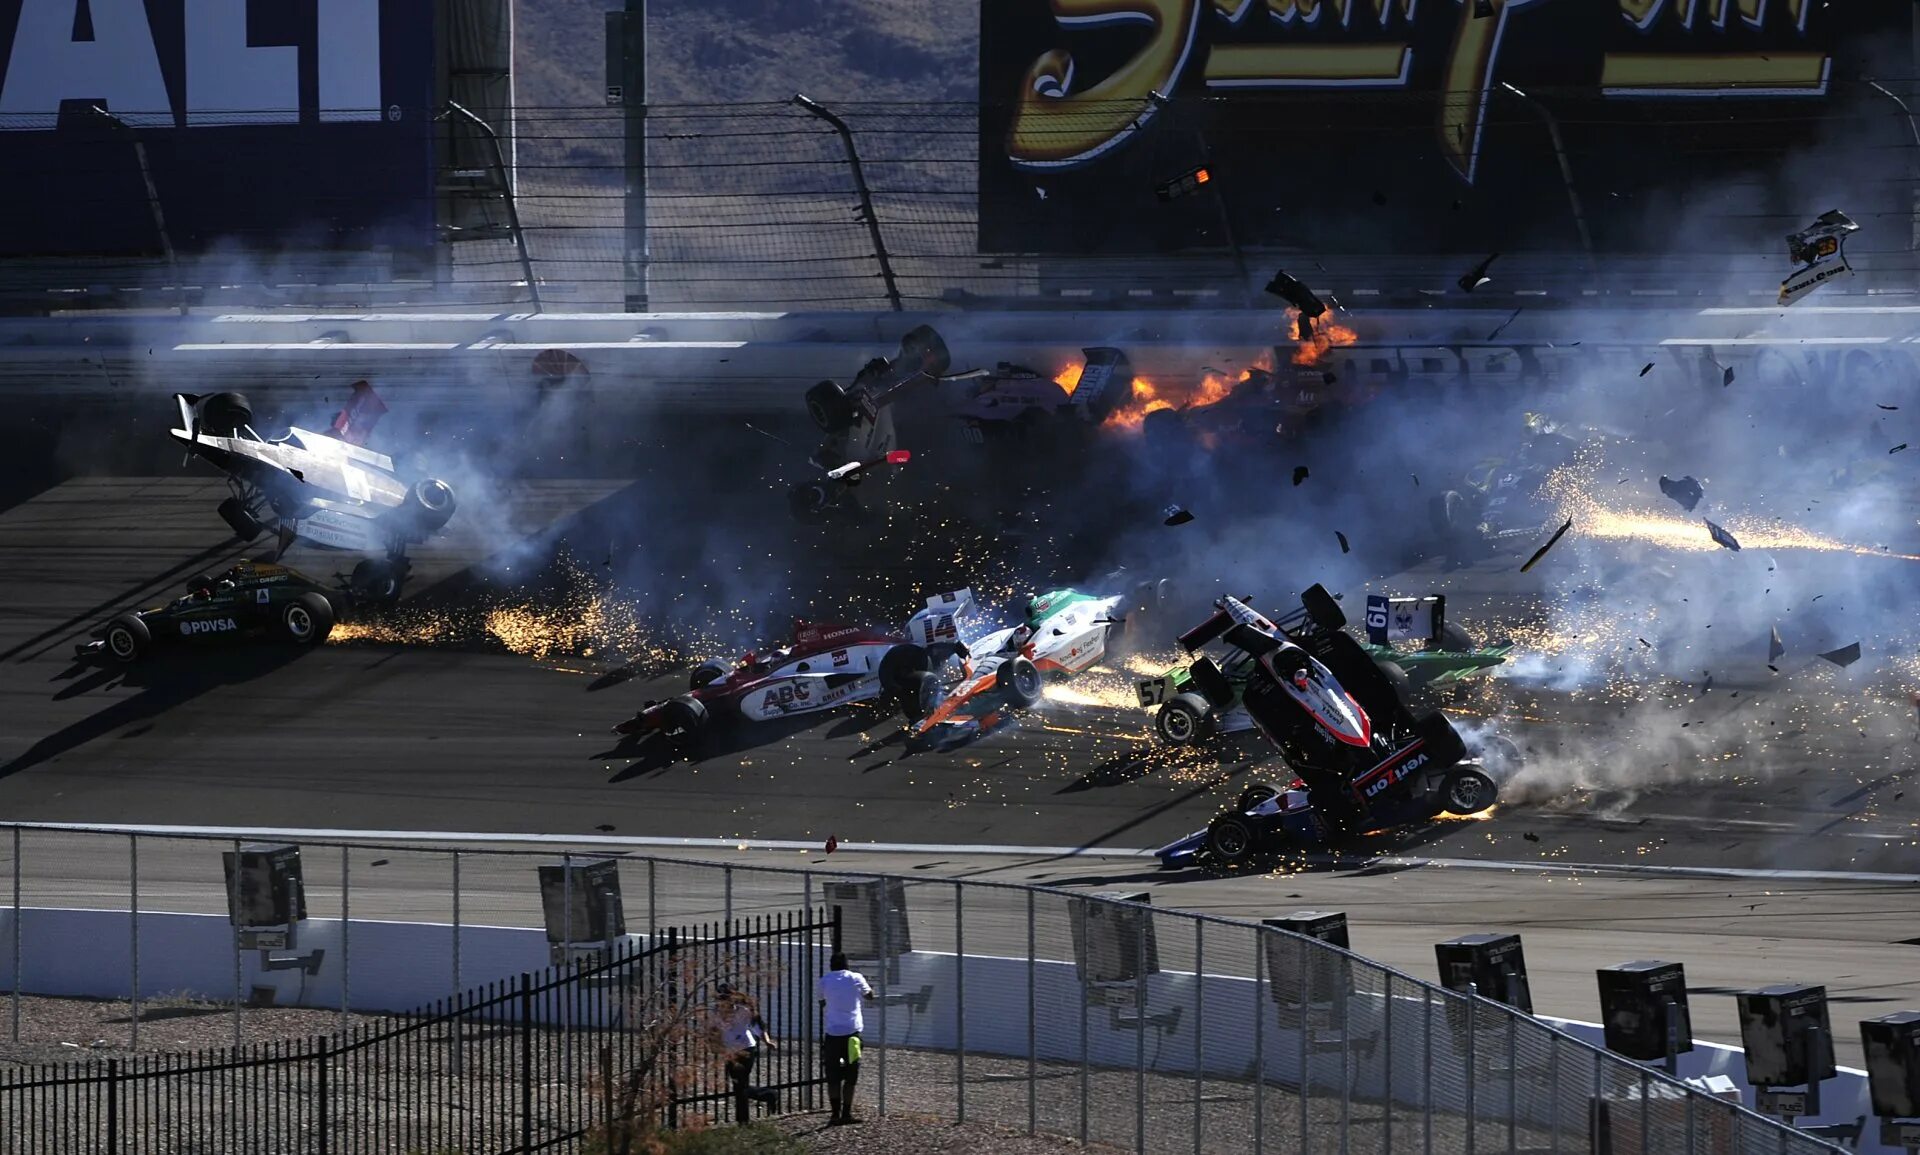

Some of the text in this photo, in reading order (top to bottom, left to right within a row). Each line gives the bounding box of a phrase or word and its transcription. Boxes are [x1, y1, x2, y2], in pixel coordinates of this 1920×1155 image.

[191, 618, 237, 634] PDVSA
[1367, 602, 1388, 628] 19
[823, 627, 860, 640] HONDA
[923, 614, 957, 643] 14
[831, 654, 848, 664] GAF
[762, 682, 810, 709] ABC
[1140, 679, 1165, 706] 57
[1365, 753, 1429, 797] verizon
